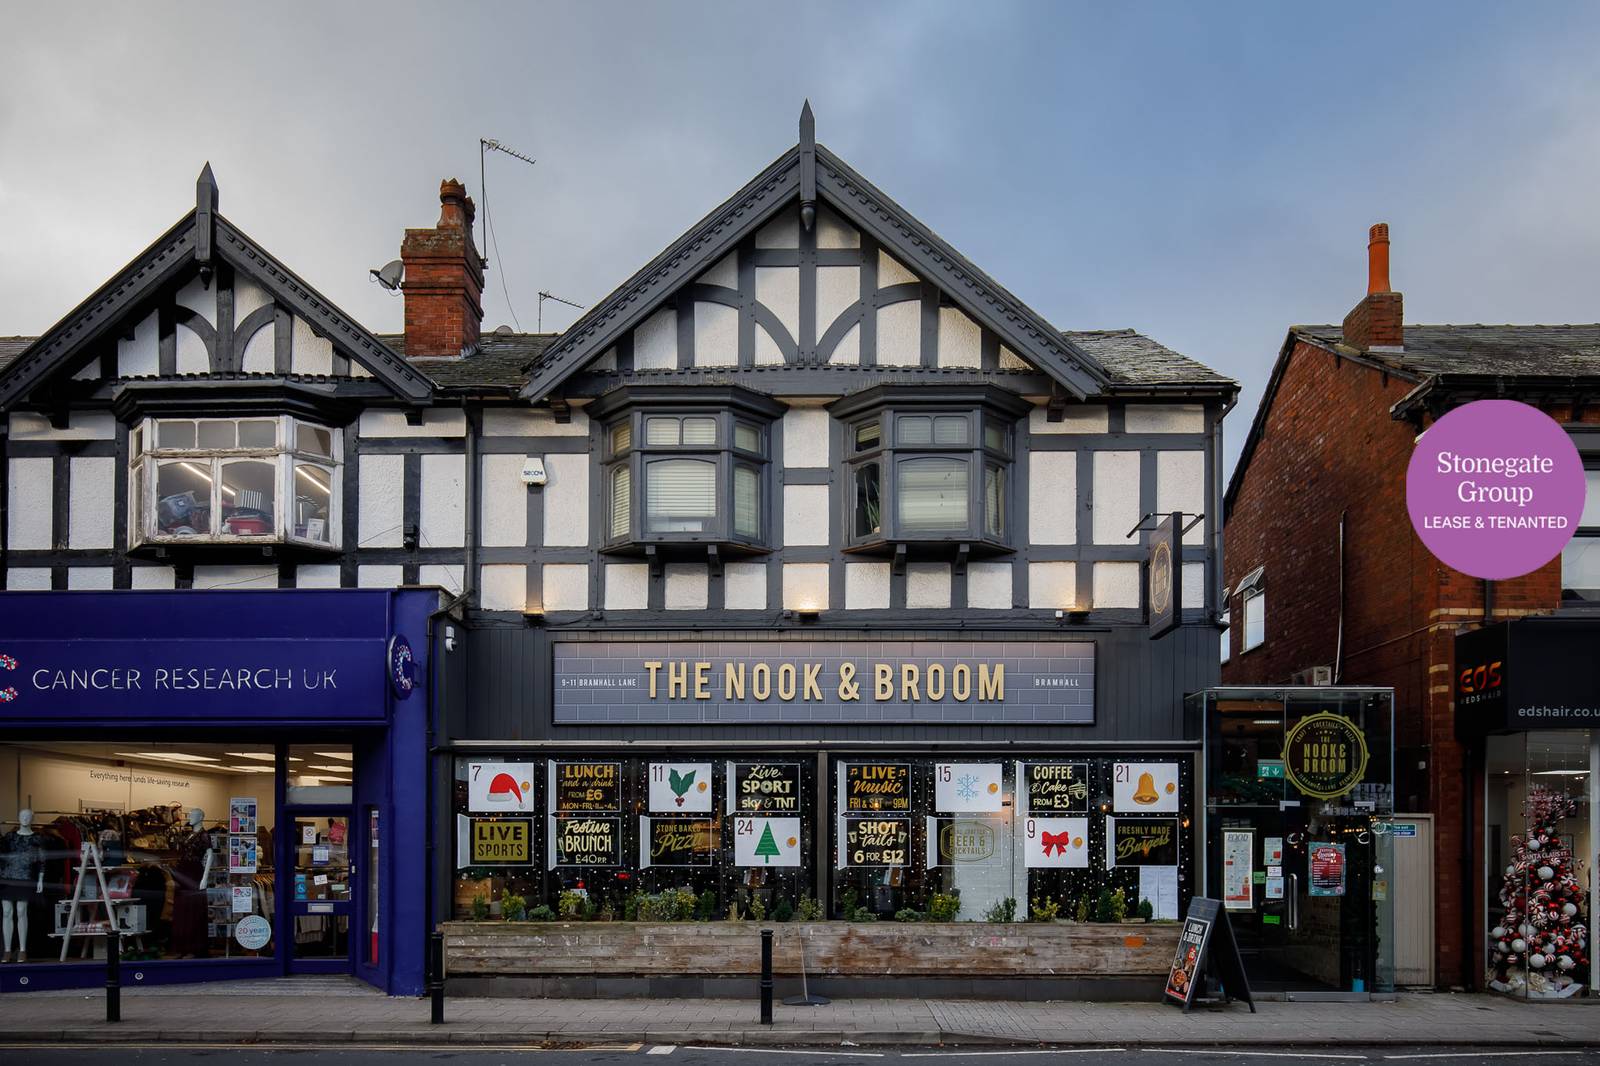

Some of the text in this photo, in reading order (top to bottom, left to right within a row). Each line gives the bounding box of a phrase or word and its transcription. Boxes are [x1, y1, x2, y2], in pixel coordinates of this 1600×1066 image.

[31, 668, 337, 691] CANCER RESEARCH UK
[561, 678, 637, 687] 9-11 BRAMHALL LANE
[644, 662, 1005, 702] THE NOOK & BROOM
[1035, 678, 1080, 688] BRAMHALL
[472, 765, 482, 782] 7
[565, 765, 614, 779] LUNCH
[652, 765, 663, 782] 11
[748, 765, 783, 780] Live
[862, 766, 897, 780] LIVE
[1034, 765, 1073, 780] COFFEE
[1116, 764, 1130, 783] 21
[1303, 759, 1347, 774] BROOM
[90, 770, 118, 782] Everything
[147, 777, 171, 788] life-saving
[938, 766, 952, 783] 15
[568, 788, 603, 801] FROM £6
[742, 780, 793, 794] SPORT
[1041, 780, 1069, 794] Cake
[742, 796, 762, 809] sky
[774, 797, 796, 808] TNT
[850, 797, 861, 809] FRI
[862, 799, 869, 809] &
[1033, 794, 1070, 809] FROM £3
[478, 826, 523, 841] LIVE
[564, 820, 610, 835] Festive
[656, 824, 678, 834] STONE
[737, 819, 754, 836] 24
[859, 821, 898, 835] SHOT
[1027, 819, 1036, 839] 9
[1117, 826, 1171, 835] FRESHLY MADE
[565, 835, 612, 853] BRUNCH
[1227, 833, 1249, 842] FOOD
[478, 843, 523, 857] SPORTS
[854, 849, 905, 864] 6 FOR £12
